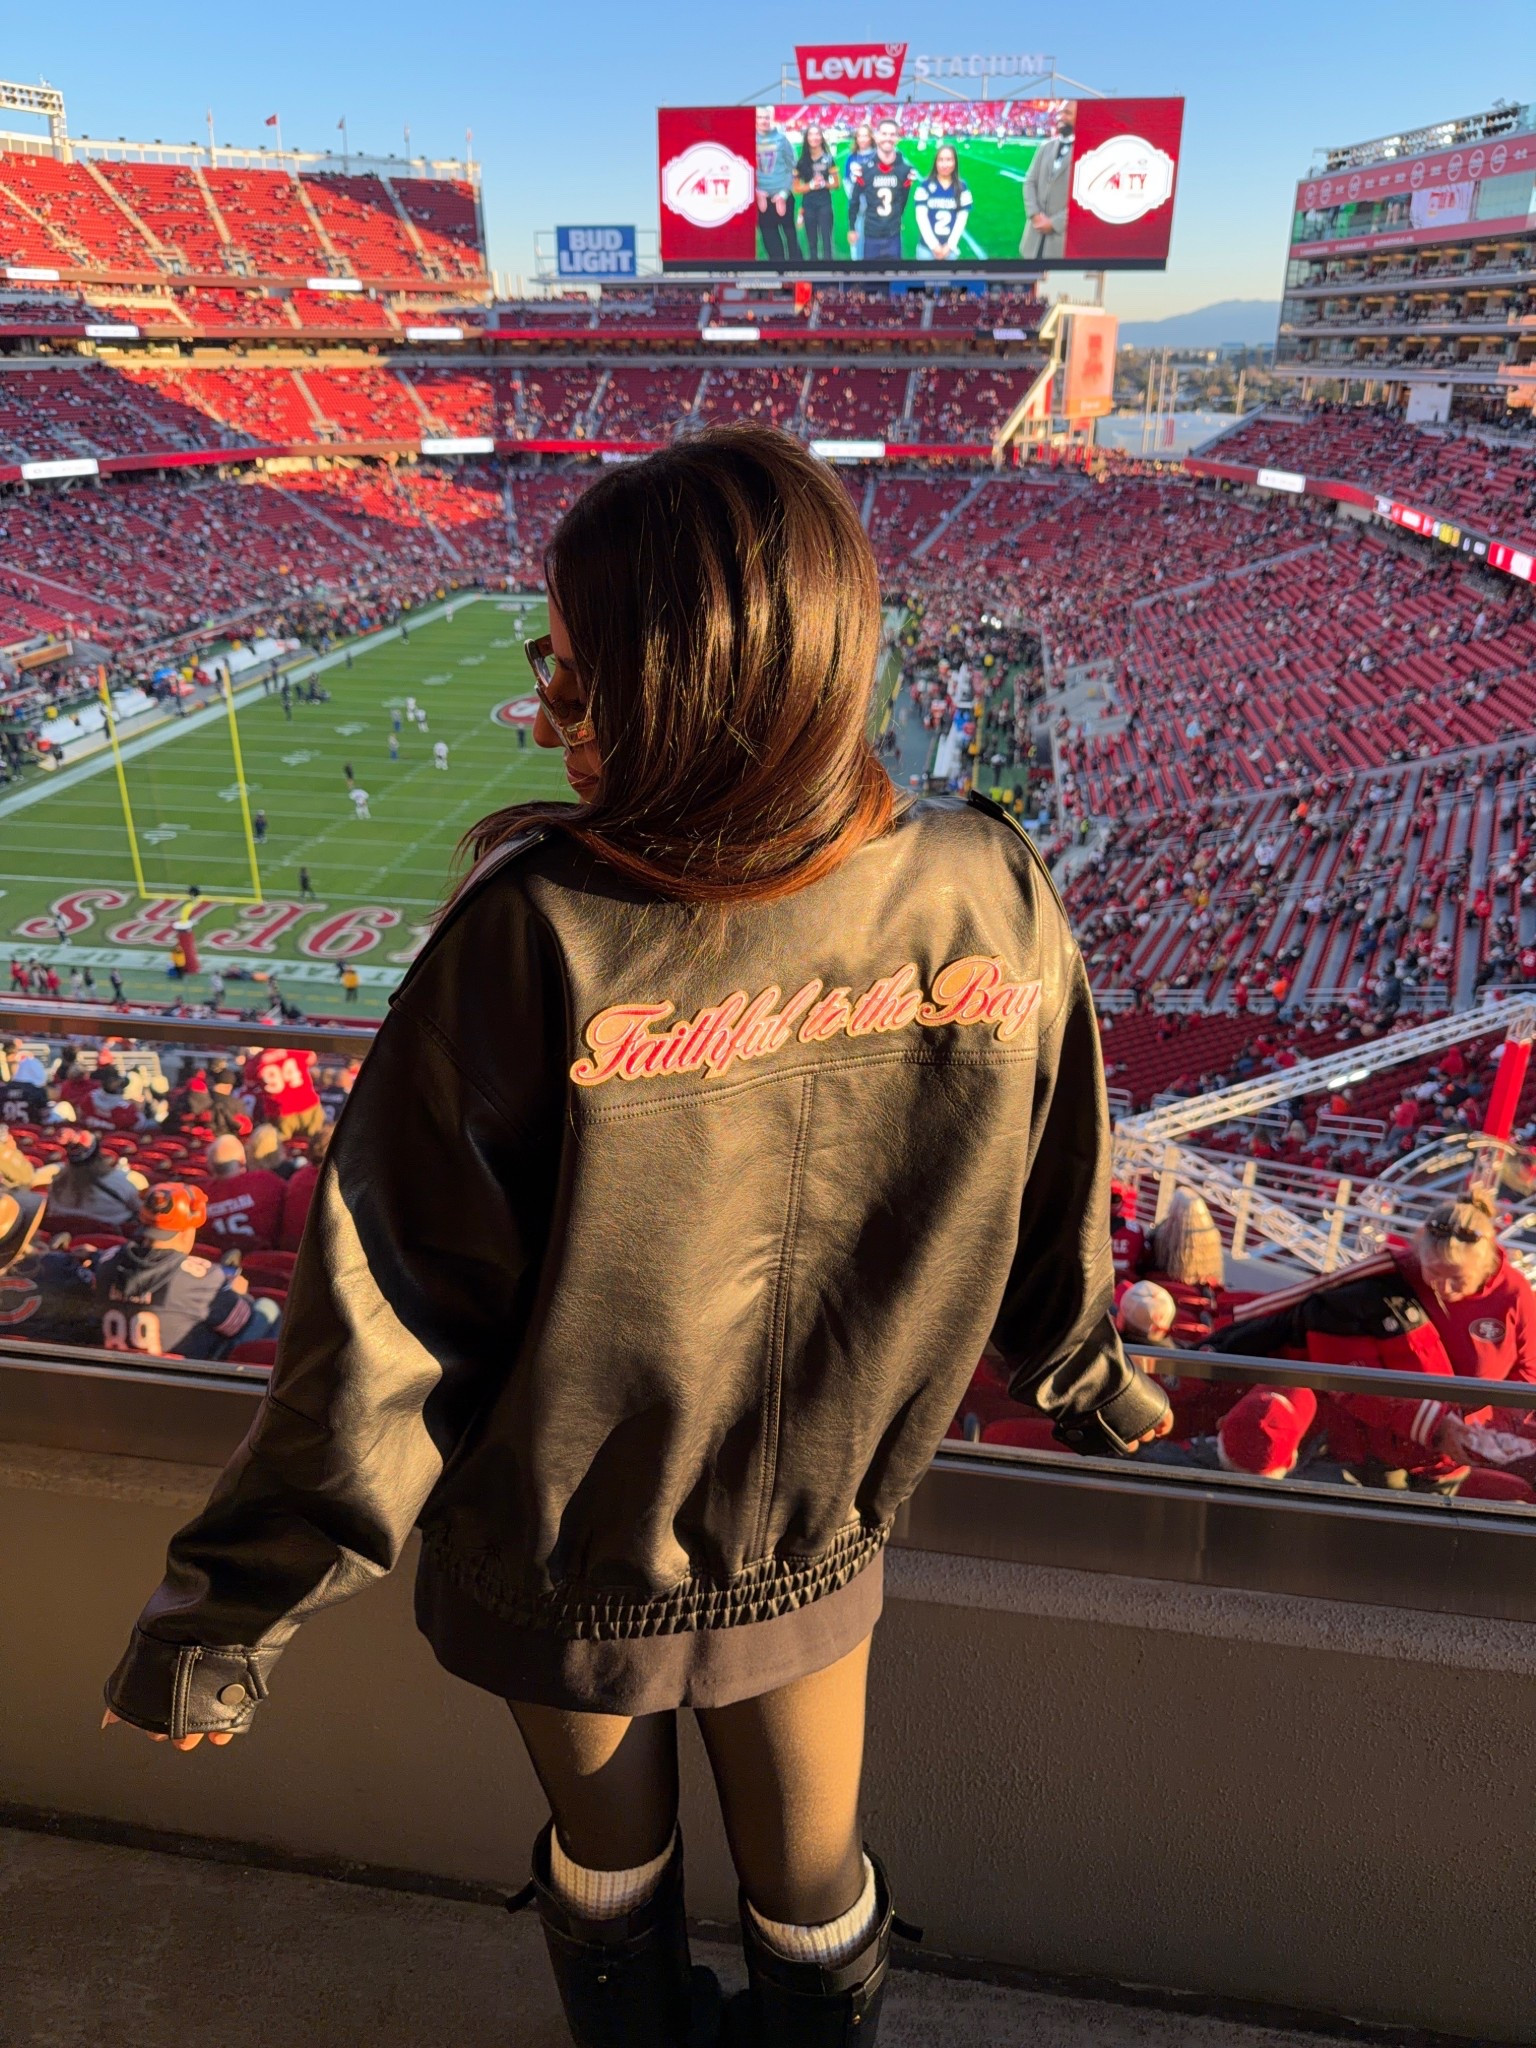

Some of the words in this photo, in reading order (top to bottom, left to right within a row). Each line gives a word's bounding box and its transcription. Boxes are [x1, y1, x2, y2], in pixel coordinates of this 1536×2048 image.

[913, 53, 1046, 78] STADIUM
[876, 187, 893, 217] 3
[933, 209, 952, 236] 2
[568, 228, 624, 252] BUD
[559, 249, 634, 273] LIGHT
[569, 977, 824, 1087] Faithful
[799, 986, 852, 1043] to
[845, 962, 925, 1037] the
[915, 953, 1044, 1042] Bay
[261, 1058, 304, 1094] 94
